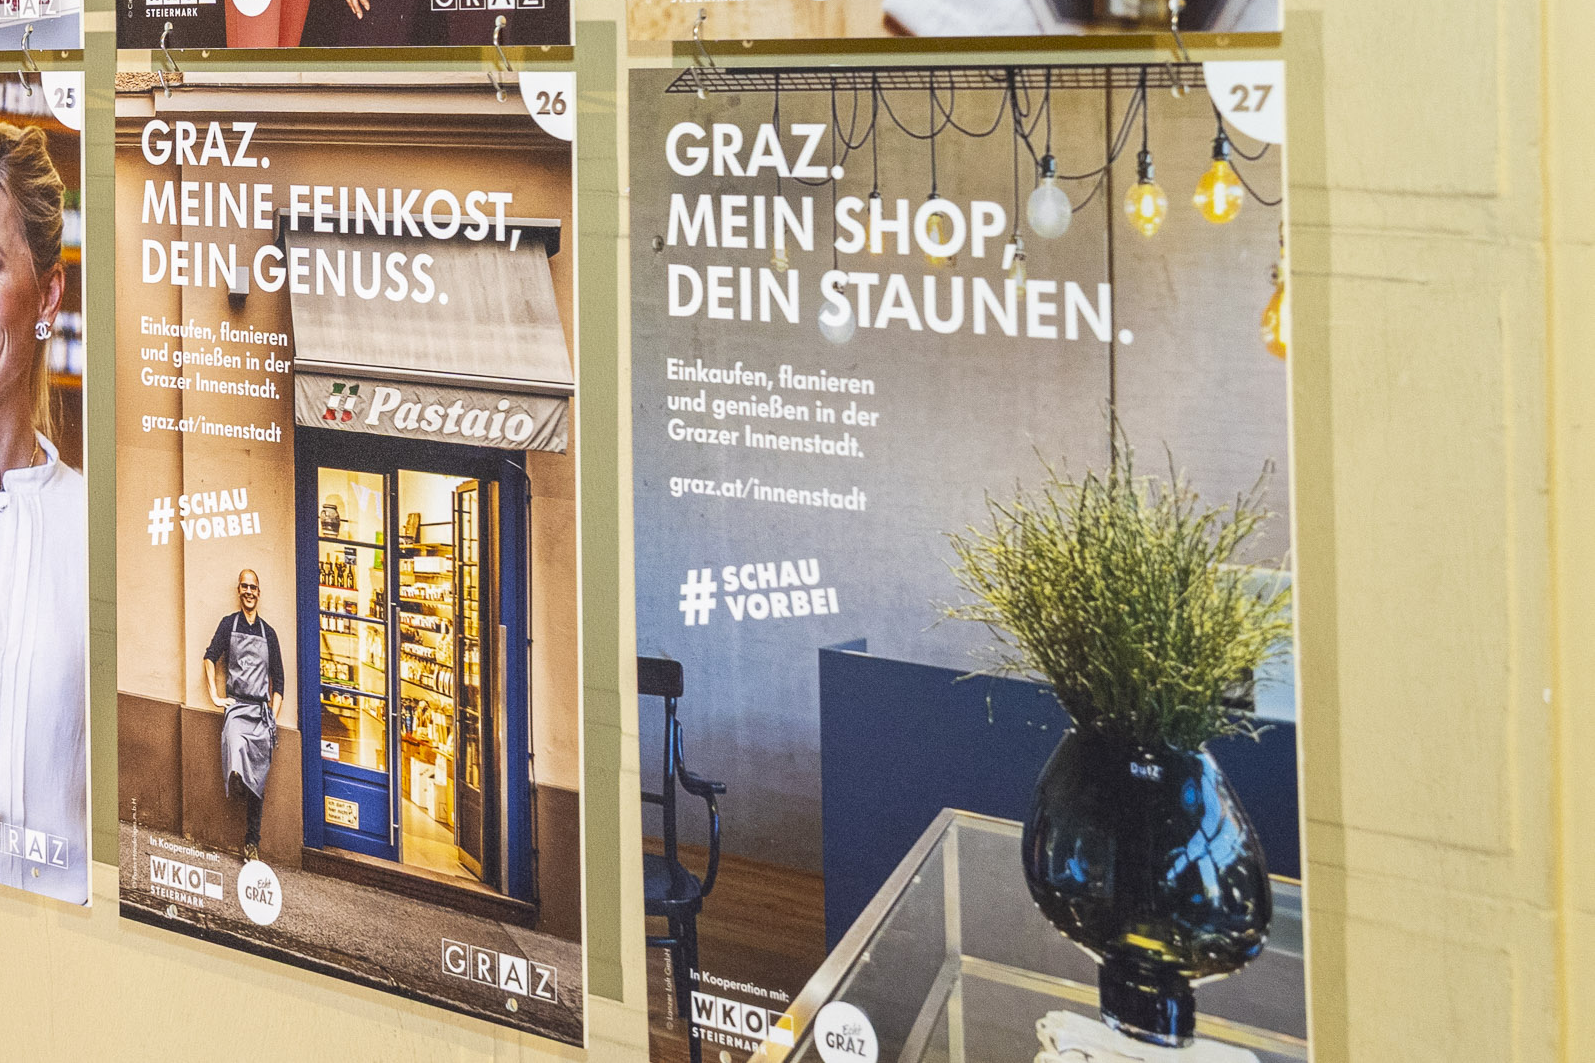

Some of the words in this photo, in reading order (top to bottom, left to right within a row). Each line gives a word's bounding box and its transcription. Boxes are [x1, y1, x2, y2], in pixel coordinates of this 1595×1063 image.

[146, 8, 198, 17] STEIERMARK
[54, 88, 76, 109] 25
[536, 91, 567, 116] 26
[1229, 84, 1274, 114] 27
[141, 120, 270, 169] GRAZ.
[665, 121, 845, 178] GRAZ.
[142, 180, 273, 230] MEINE
[289, 186, 523, 252] FEINKOST,
[666, 193, 815, 252] MEIN
[833, 195, 1017, 270] SHOP,
[142, 240, 237, 288] DEIN
[253, 245, 449, 305] GENUSS.
[667, 264, 800, 323] DEIN
[819, 269, 1133, 346] STAUNEN.
[666, 357, 774, 391] Einkaufen,
[778, 364, 875, 395] flanieren
[366, 386, 535, 441] Pastaio
[667, 390, 706, 414] und
[712, 395, 809, 423] genießen
[815, 399, 836, 423] in
[841, 401, 879, 428] der
[667, 419, 739, 445] Grazer
[744, 424, 865, 459] Innenstadt.
[669, 474, 867, 511] graz.at/innenstadt
